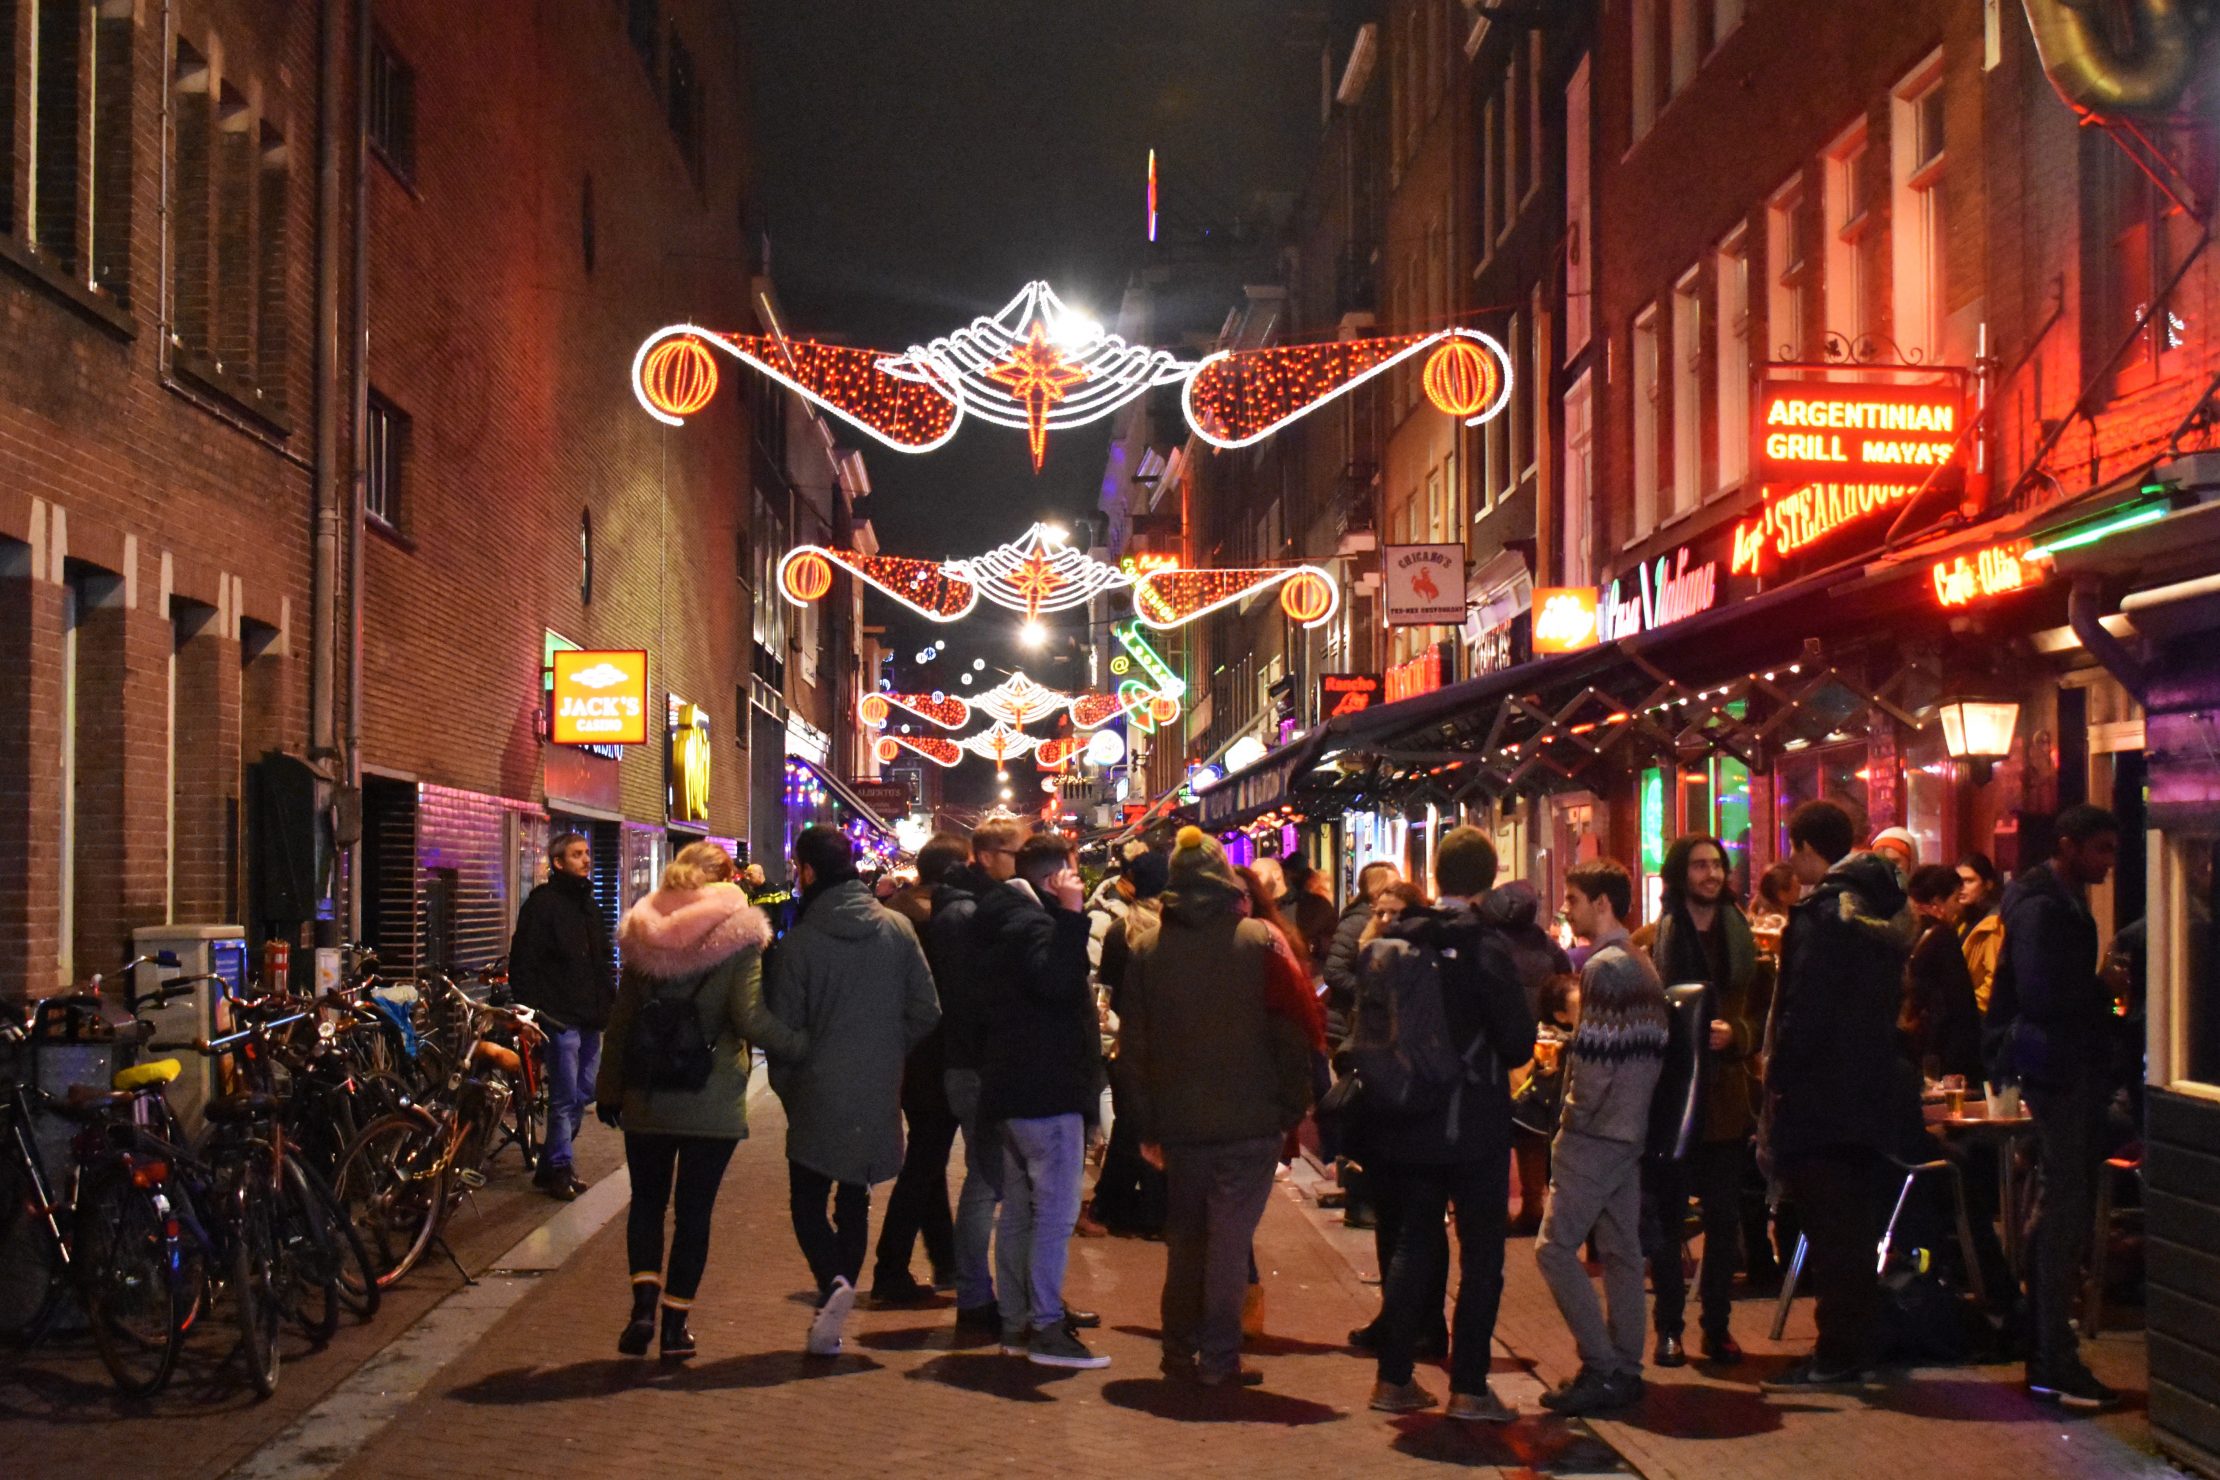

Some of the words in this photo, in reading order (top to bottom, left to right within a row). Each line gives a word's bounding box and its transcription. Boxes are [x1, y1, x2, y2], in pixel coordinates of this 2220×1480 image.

[1768, 399, 1952, 431] ARGENTINIAN
[1767, 433, 1848, 461] GRILL
[1862, 440, 1954, 465] MAYA'S
[1398, 551, 1452, 569] CHICANO'S
[1325, 675, 1377, 692] Rancho
[559, 696, 640, 717] JACK'S
[576, 718, 623, 732] CASINO
